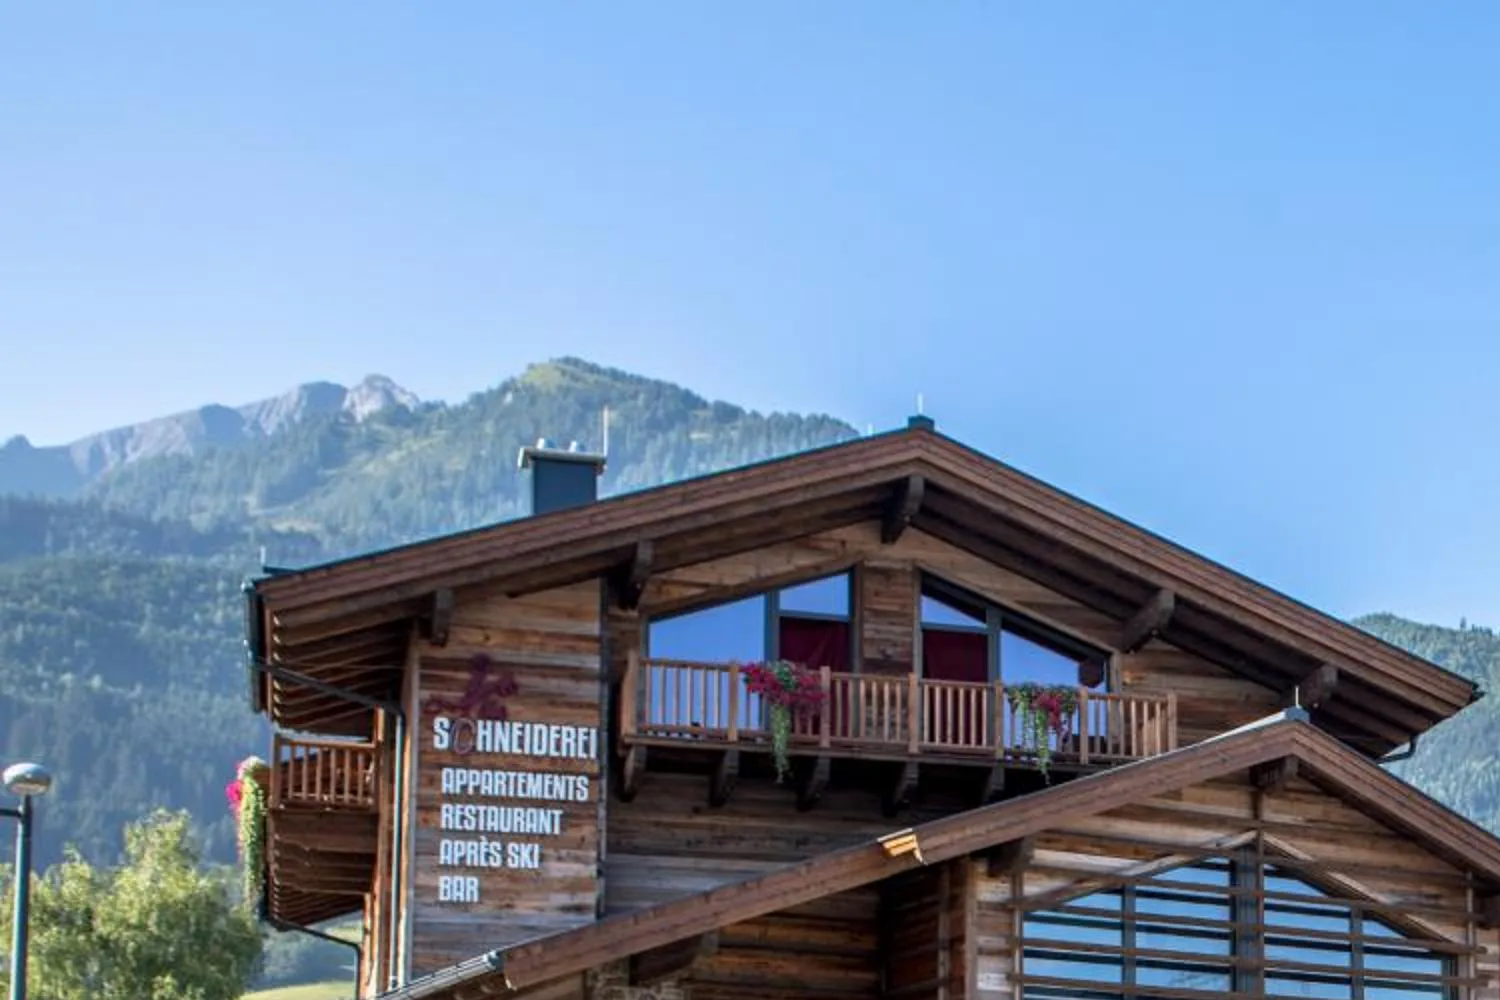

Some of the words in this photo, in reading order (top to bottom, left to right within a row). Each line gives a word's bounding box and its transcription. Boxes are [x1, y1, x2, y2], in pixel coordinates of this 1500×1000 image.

[441, 767, 589, 801] APPARTEMENTS
[440, 804, 563, 835] RESTAURANT
[438, 836, 502, 868] APRÈS
[506, 843, 540, 869] SKI
[437, 875, 480, 903] BAR
